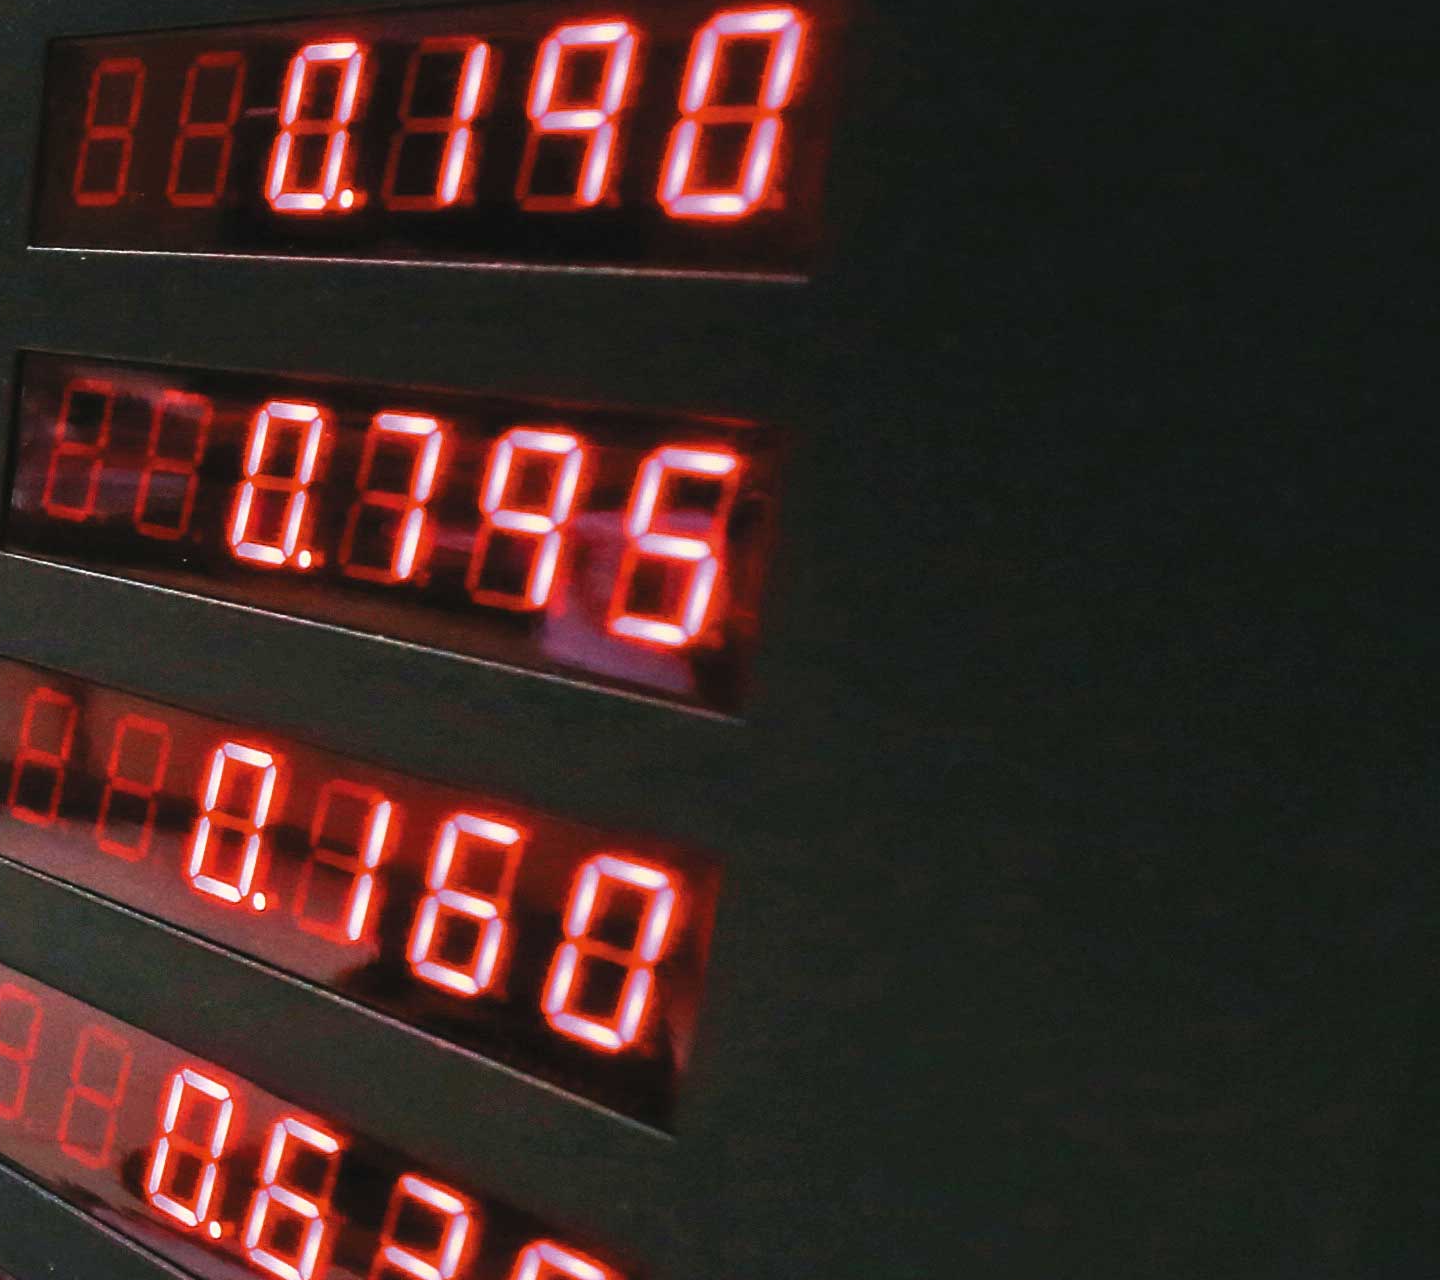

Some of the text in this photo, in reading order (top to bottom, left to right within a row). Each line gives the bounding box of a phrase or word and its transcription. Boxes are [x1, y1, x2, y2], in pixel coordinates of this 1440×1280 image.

[266, 5, 804, 219] 0.190
[229, 400, 740, 648] 0.795
[188, 740, 676, 1053] 0.160
